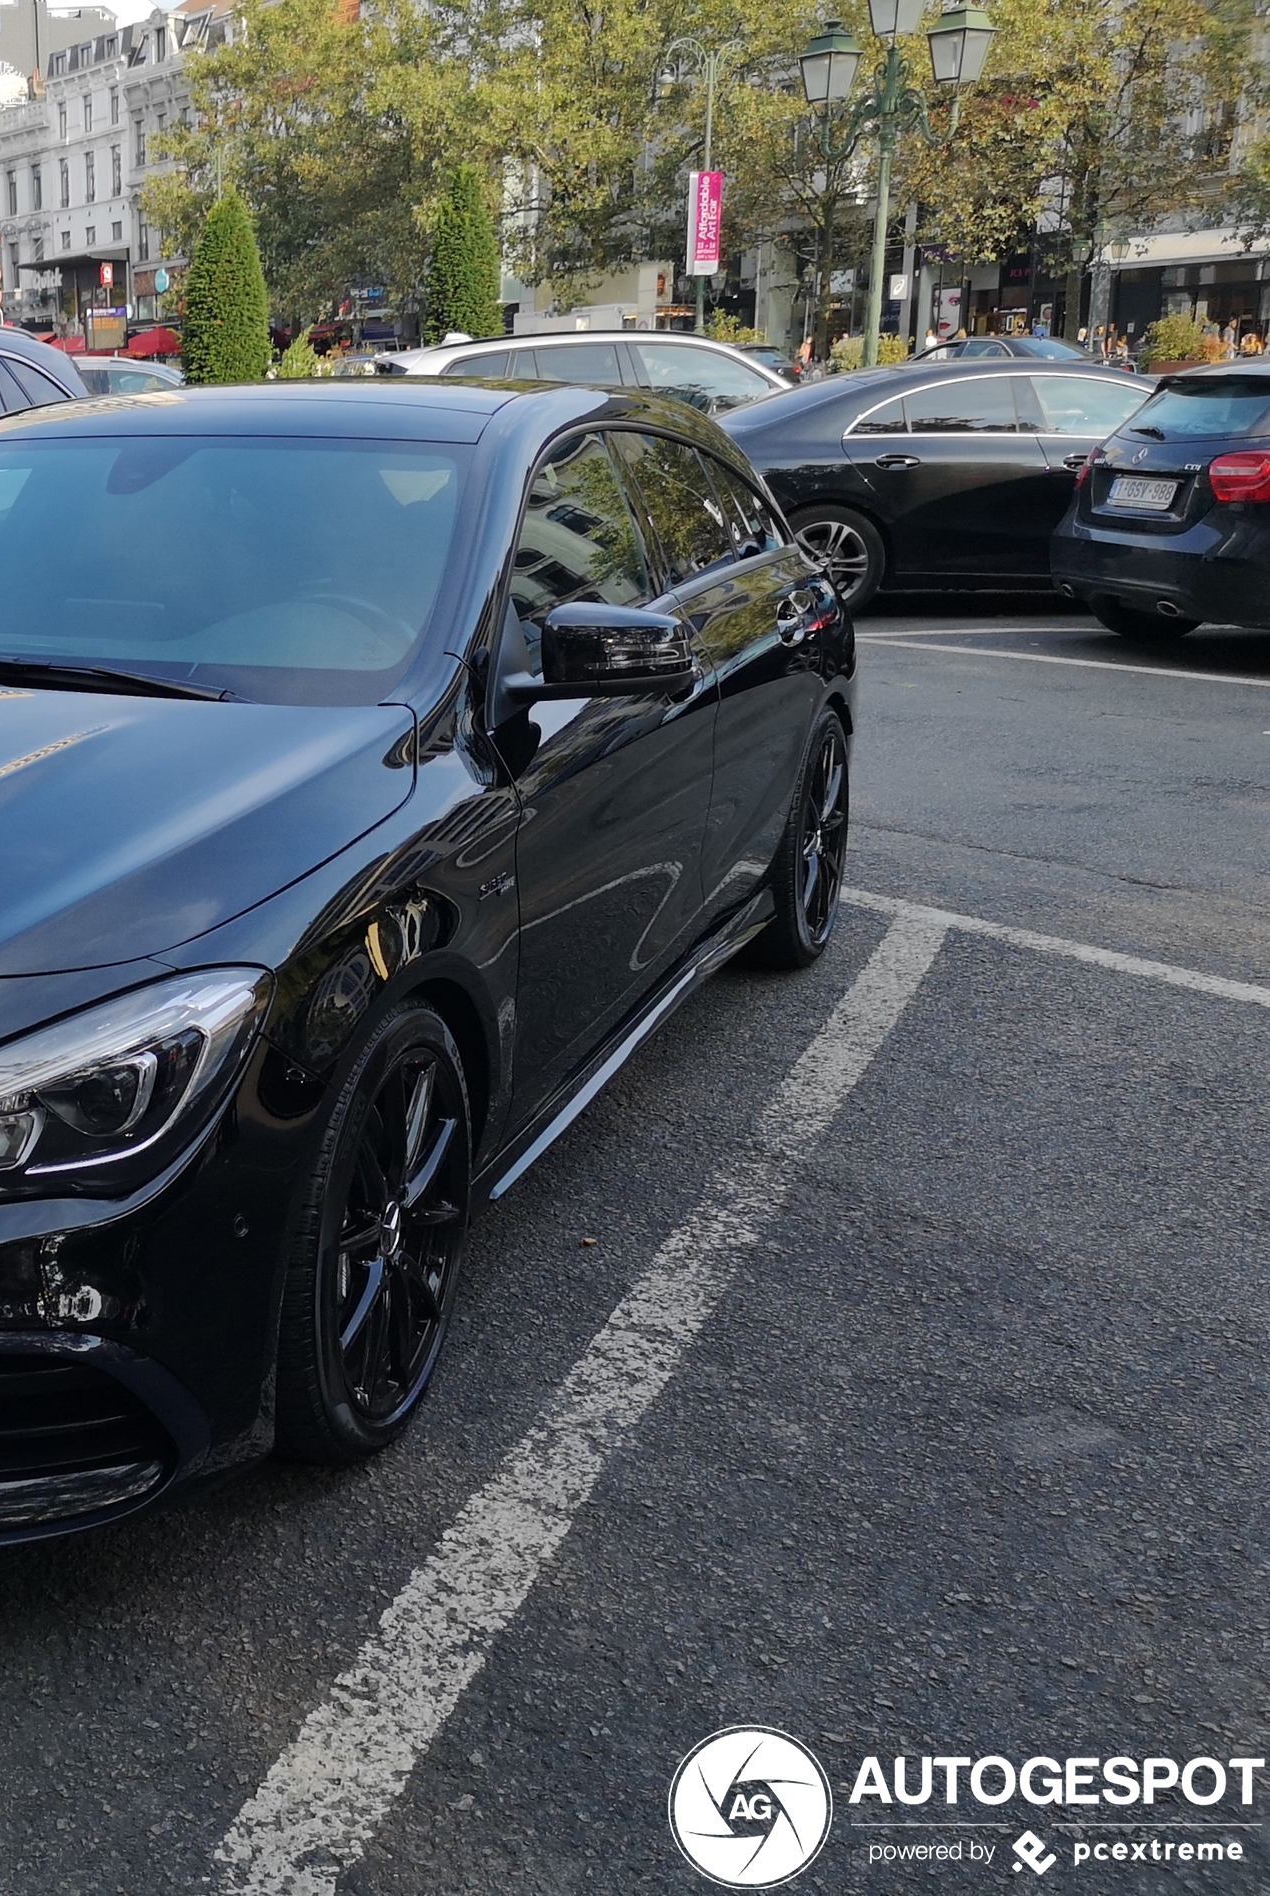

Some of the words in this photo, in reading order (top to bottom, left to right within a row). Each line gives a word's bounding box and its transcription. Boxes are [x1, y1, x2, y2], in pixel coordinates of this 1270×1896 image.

[697, 175, 710, 241] Affordable
[708, 198, 718, 220] Fair
[707, 220, 718, 241] Art
[32, 266, 63, 292] Quick
